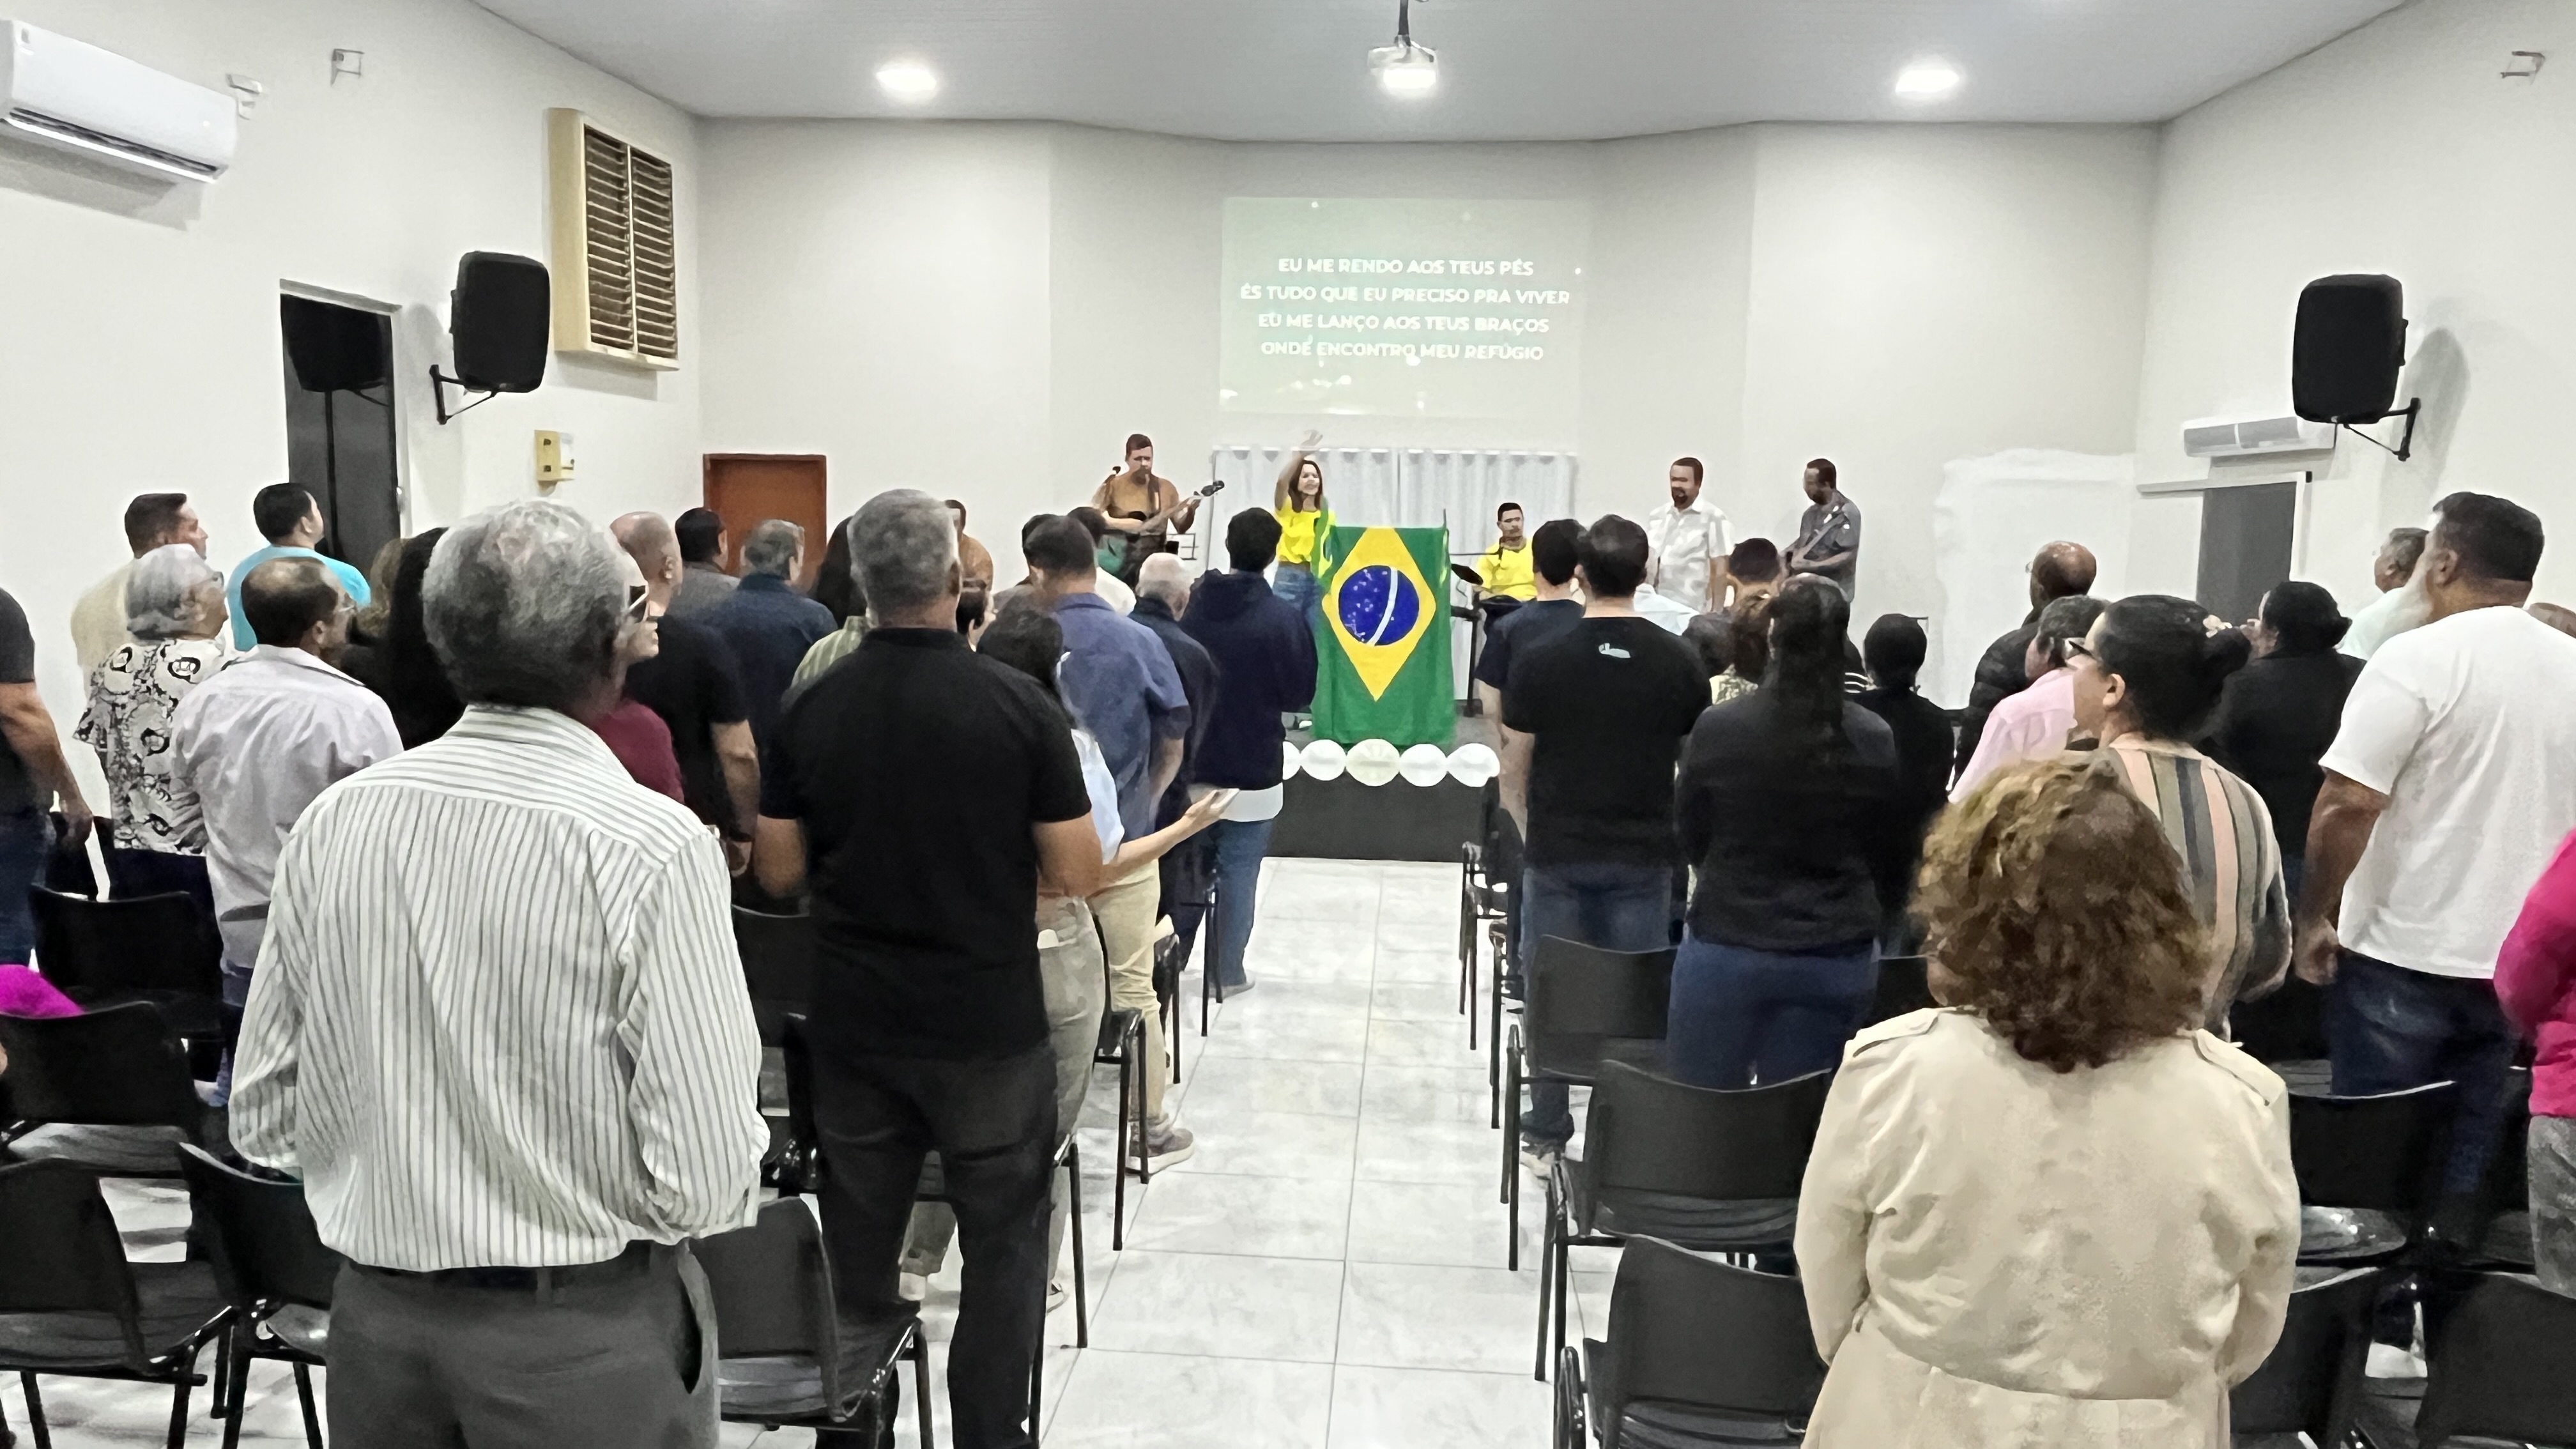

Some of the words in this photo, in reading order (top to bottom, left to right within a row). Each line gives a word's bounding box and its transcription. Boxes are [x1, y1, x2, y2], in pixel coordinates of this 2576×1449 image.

[1278, 258, 1302, 272] EU
[1307, 259, 1334, 273] ME
[1338, 259, 1403, 273] RENDO
[1406, 259, 1445, 274] AOS
[1449, 260, 1494, 275] TEUS
[1266, 286, 1317, 300] TUDO
[1321, 286, 1358, 302] QUE
[1363, 288, 1387, 301] EU
[1392, 288, 1469, 303] PRECISO
[1474, 289, 1511, 303] PRA
[1515, 290, 1570, 305] VIVER
[1259, 314, 1282, 327] EU
[1286, 314, 1313, 328] ME
[1317, 314, 1379, 332] LANÇO
[1383, 316, 1420, 330] AOS
[1424, 316, 1469, 331] TEUS
[1475, 318, 1549, 335] BRAÇOS
[1261, 341, 1312, 355] ONDE
[1317, 342, 1416, 357] ENCONTRO
[1420, 344, 1459, 359] MEU
[1464, 342, 1544, 360] REFÚGIO
